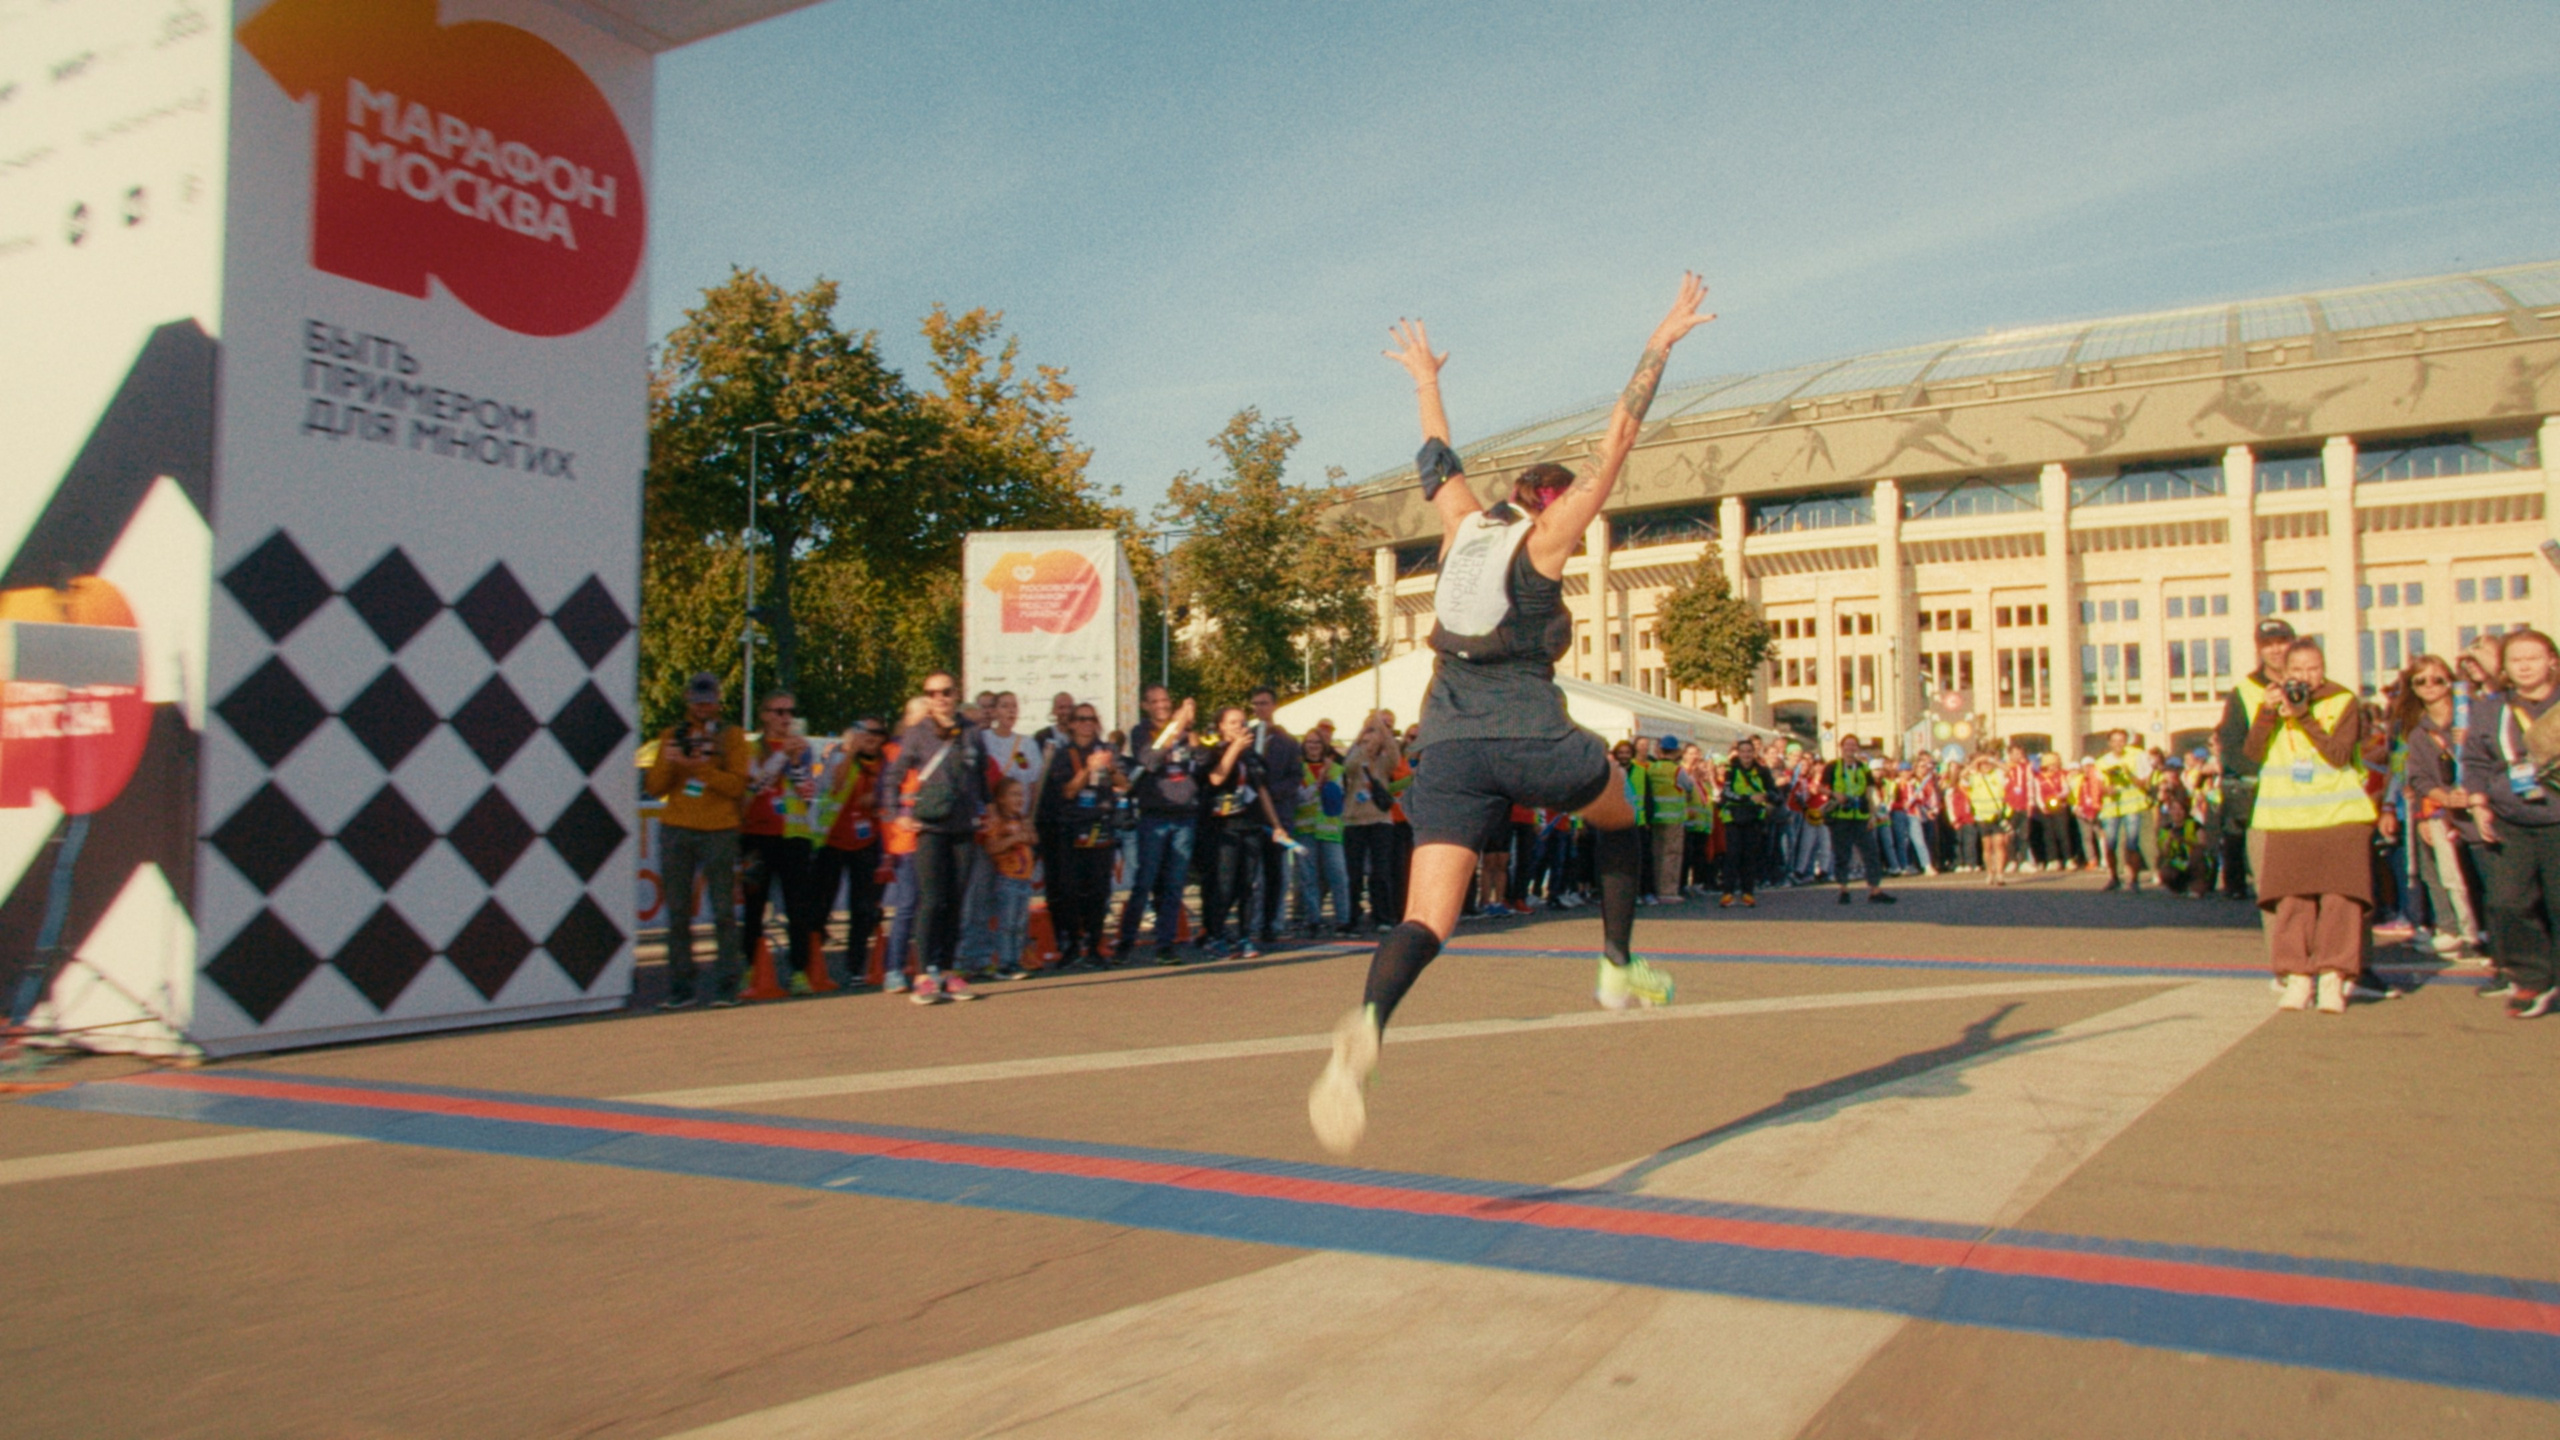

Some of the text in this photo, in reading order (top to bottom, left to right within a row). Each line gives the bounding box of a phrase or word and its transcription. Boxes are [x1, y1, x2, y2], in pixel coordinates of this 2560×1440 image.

[348, 76, 617, 217] МАРАФОН
[345, 129, 578, 250] МОСКВА
[305, 319, 421, 375] БЫТЬ
[303, 357, 537, 438] ПРИМЕРОМ
[302, 397, 576, 481] ДЛЯ МНОГИХ
[1449, 557, 1470, 613] NORTH
[1464, 559, 1484, 596] FACE
